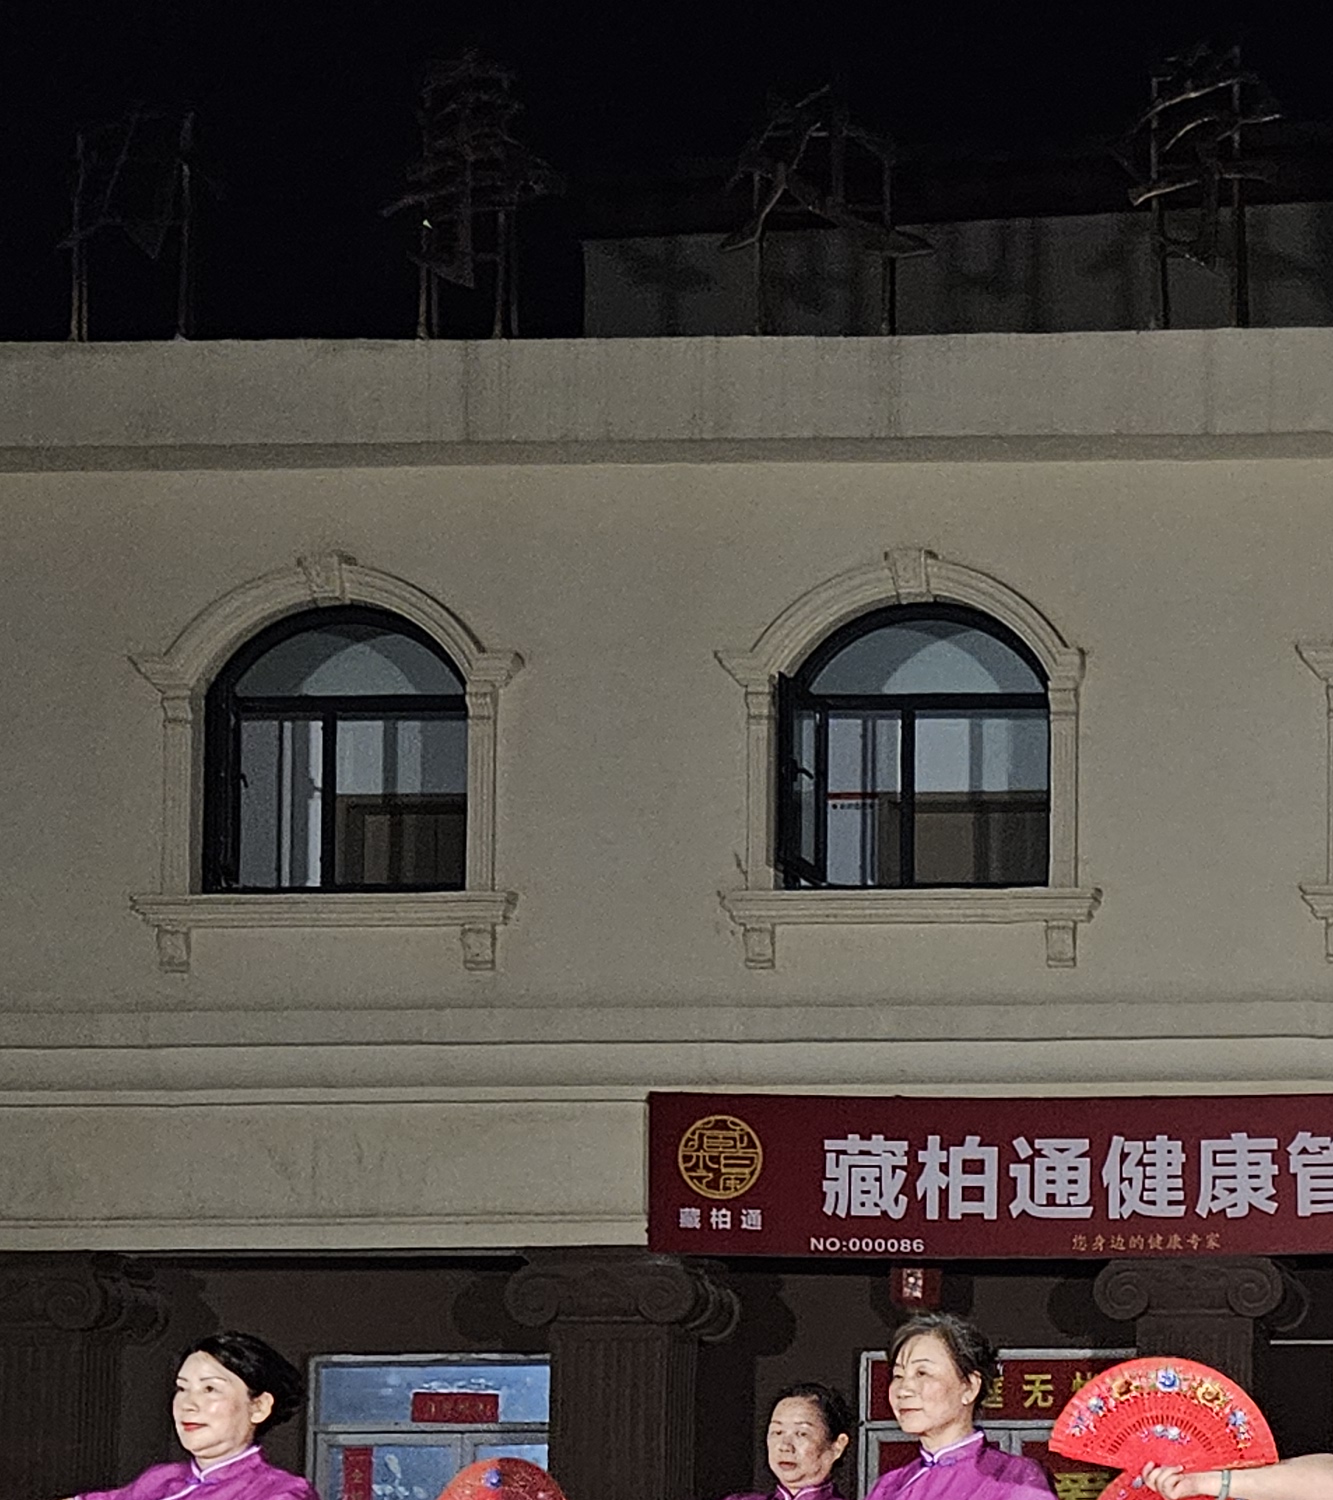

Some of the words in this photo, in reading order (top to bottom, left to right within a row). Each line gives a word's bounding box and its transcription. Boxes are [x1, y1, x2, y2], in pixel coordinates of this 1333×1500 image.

[679, 1207, 763, 1230] 藏柏通
[810, 1237, 925, 1252] NO:000086
[1071, 1232, 1221, 1251] 您身边的健康专家
